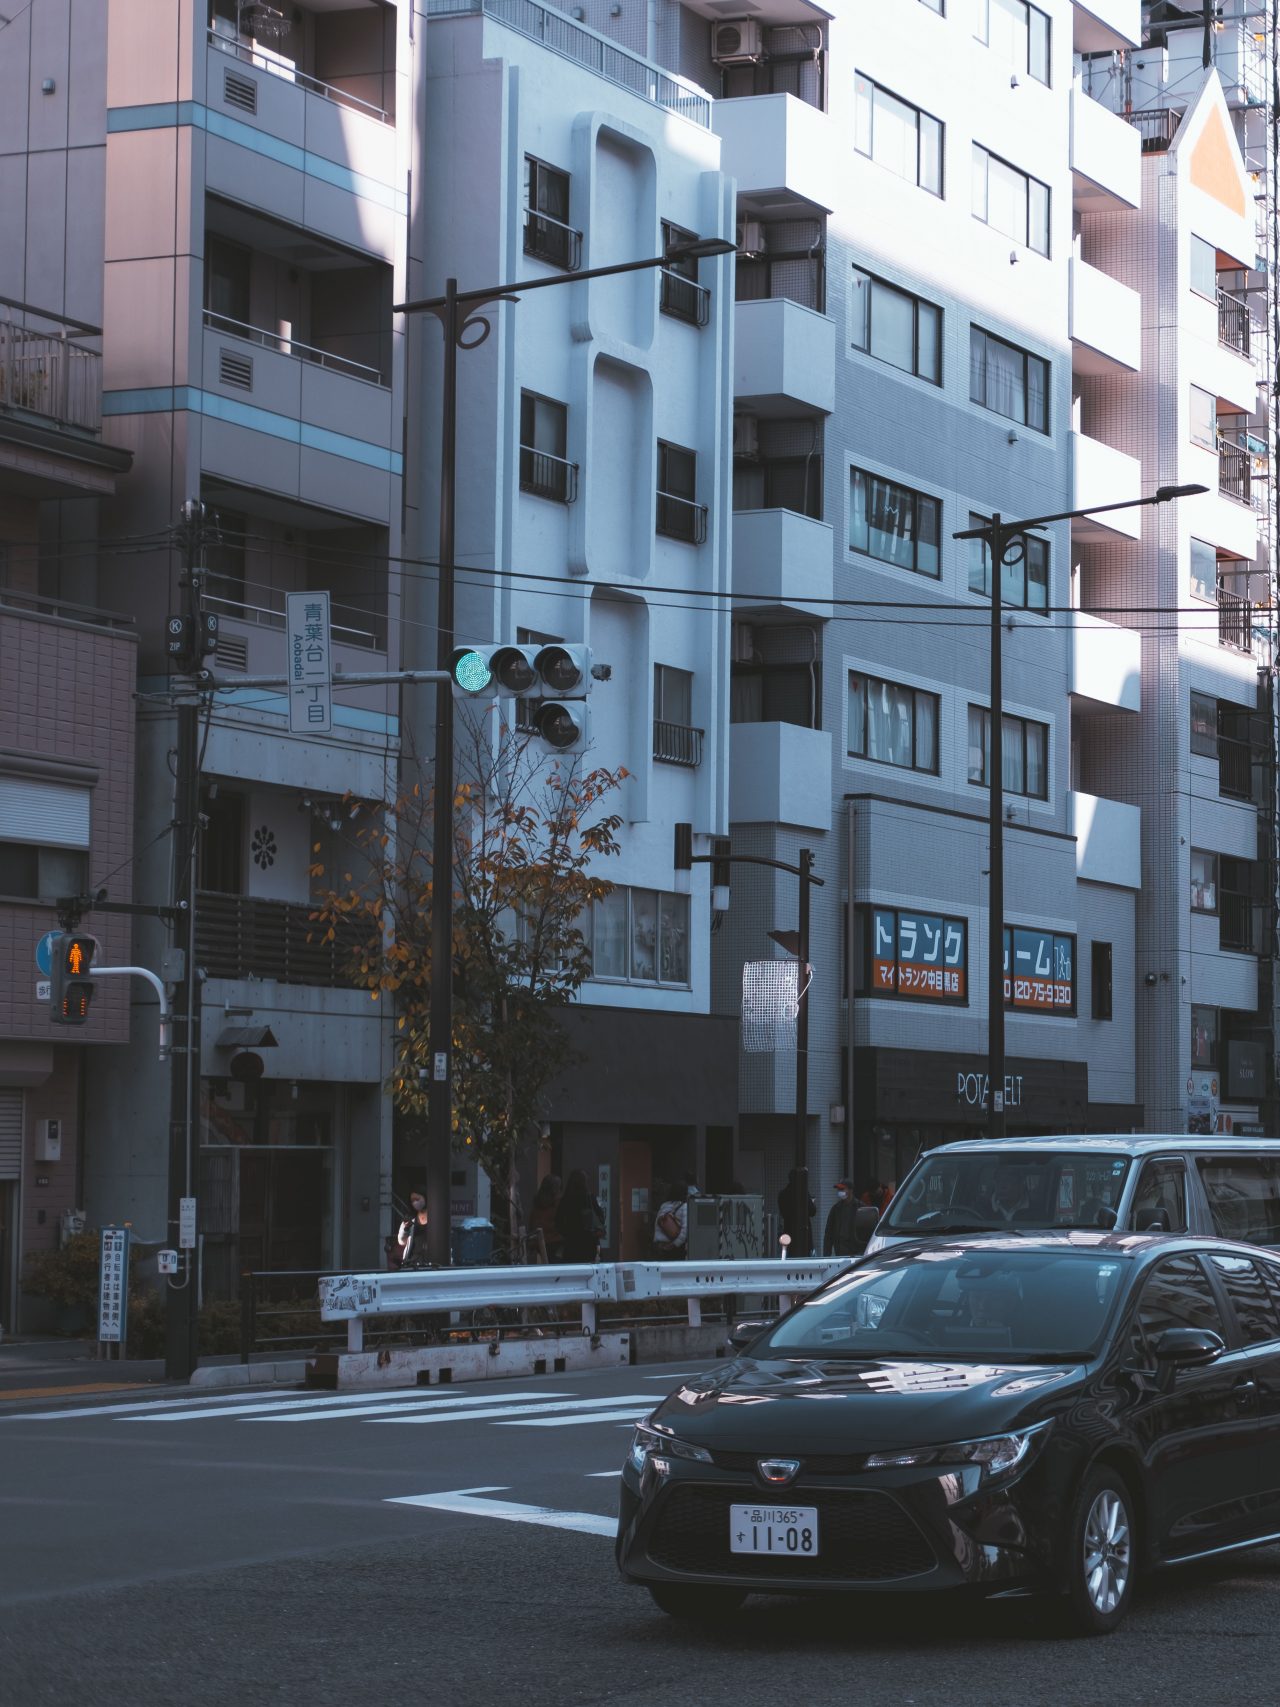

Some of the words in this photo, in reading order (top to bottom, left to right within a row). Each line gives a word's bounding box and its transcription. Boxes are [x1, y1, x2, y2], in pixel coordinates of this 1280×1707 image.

[293, 634, 305, 681] Aobadai
[304, 603, 325, 723] 青葉台一丁目
[876, 915, 962, 965] トランク
[752, 1526, 812, 1552] 11-08
